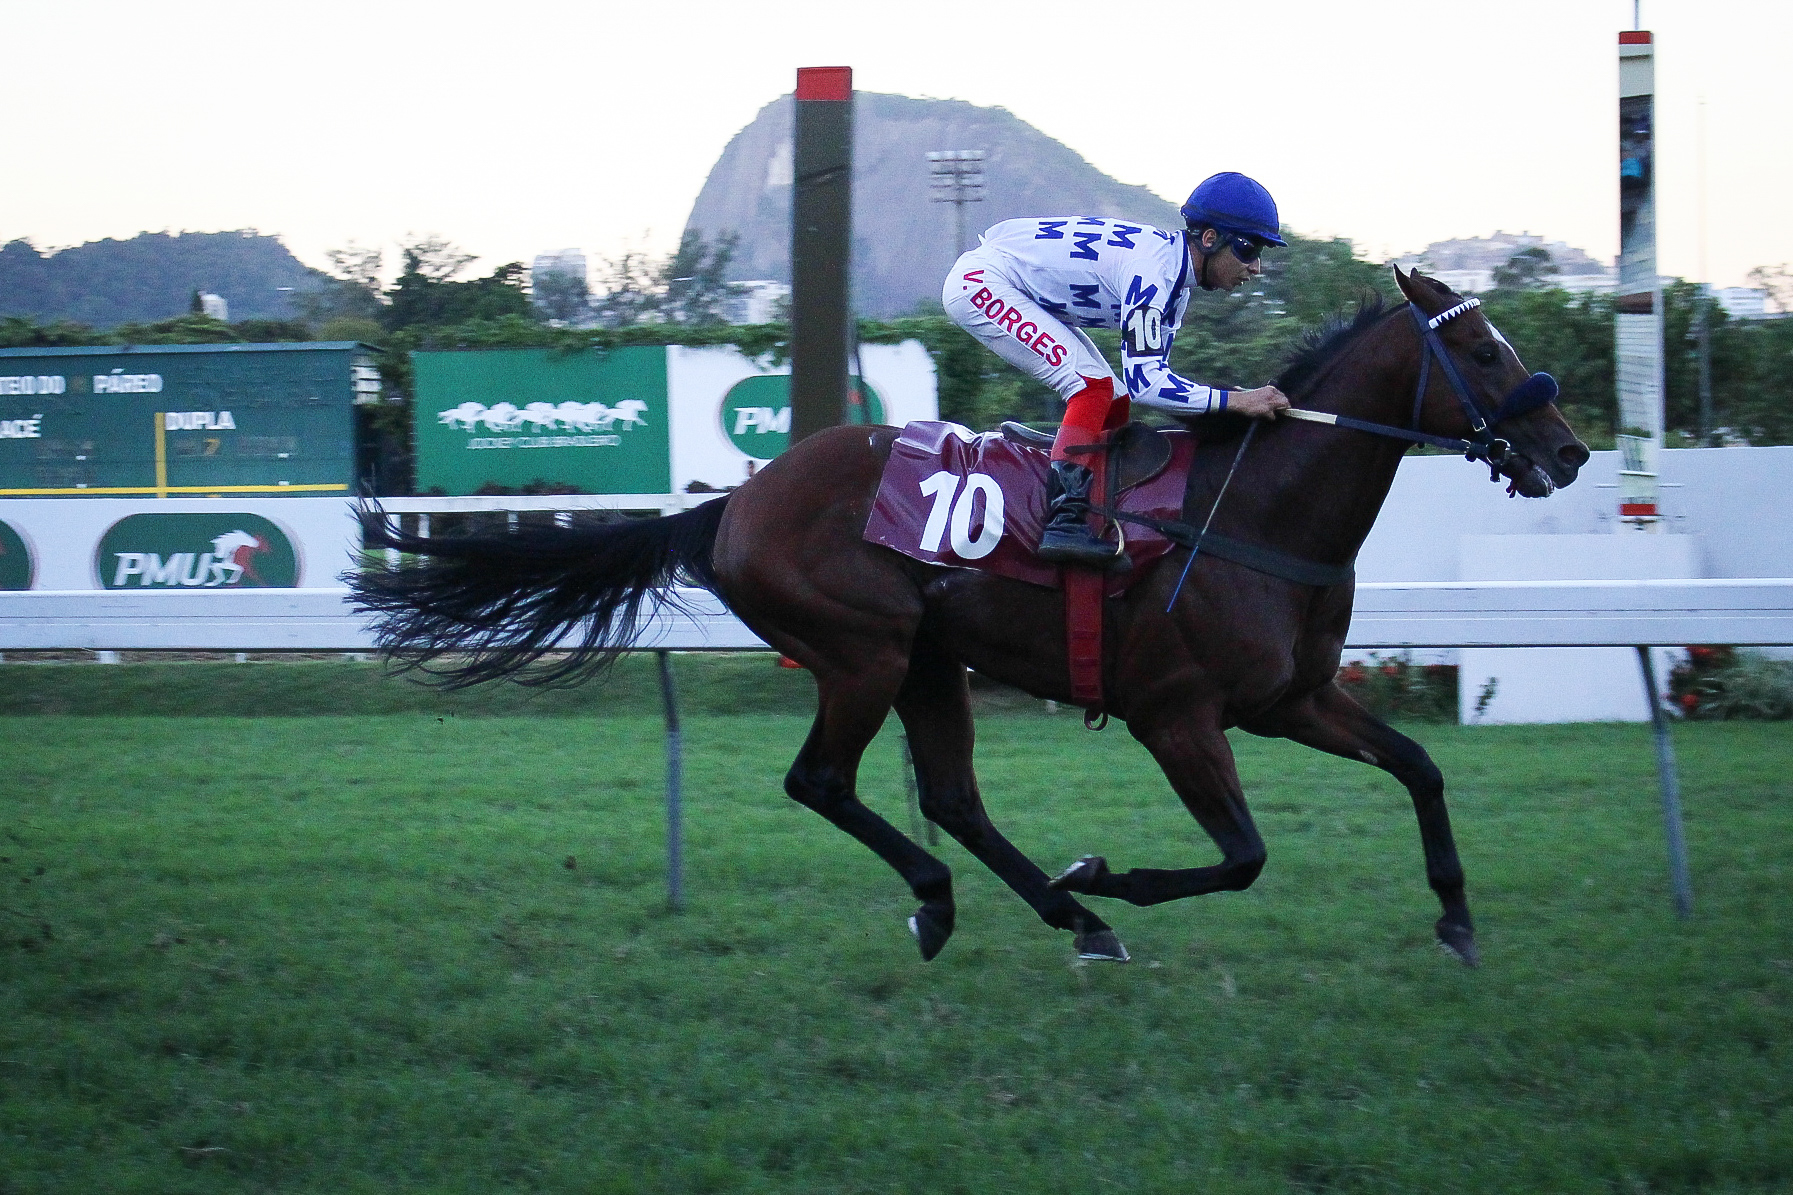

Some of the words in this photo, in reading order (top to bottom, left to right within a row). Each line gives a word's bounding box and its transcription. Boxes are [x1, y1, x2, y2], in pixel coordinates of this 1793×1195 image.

[963, 270, 984, 290] V.
[970, 287, 1067, 367] BORGES
[1127, 309, 1162, 351] 10
[0, 413, 44, 438] ACÉ
[165, 410, 237, 431] DUPLA
[733, 406, 792, 434] PM
[918, 470, 1005, 560] 10
[113, 551, 216, 587] PMU
